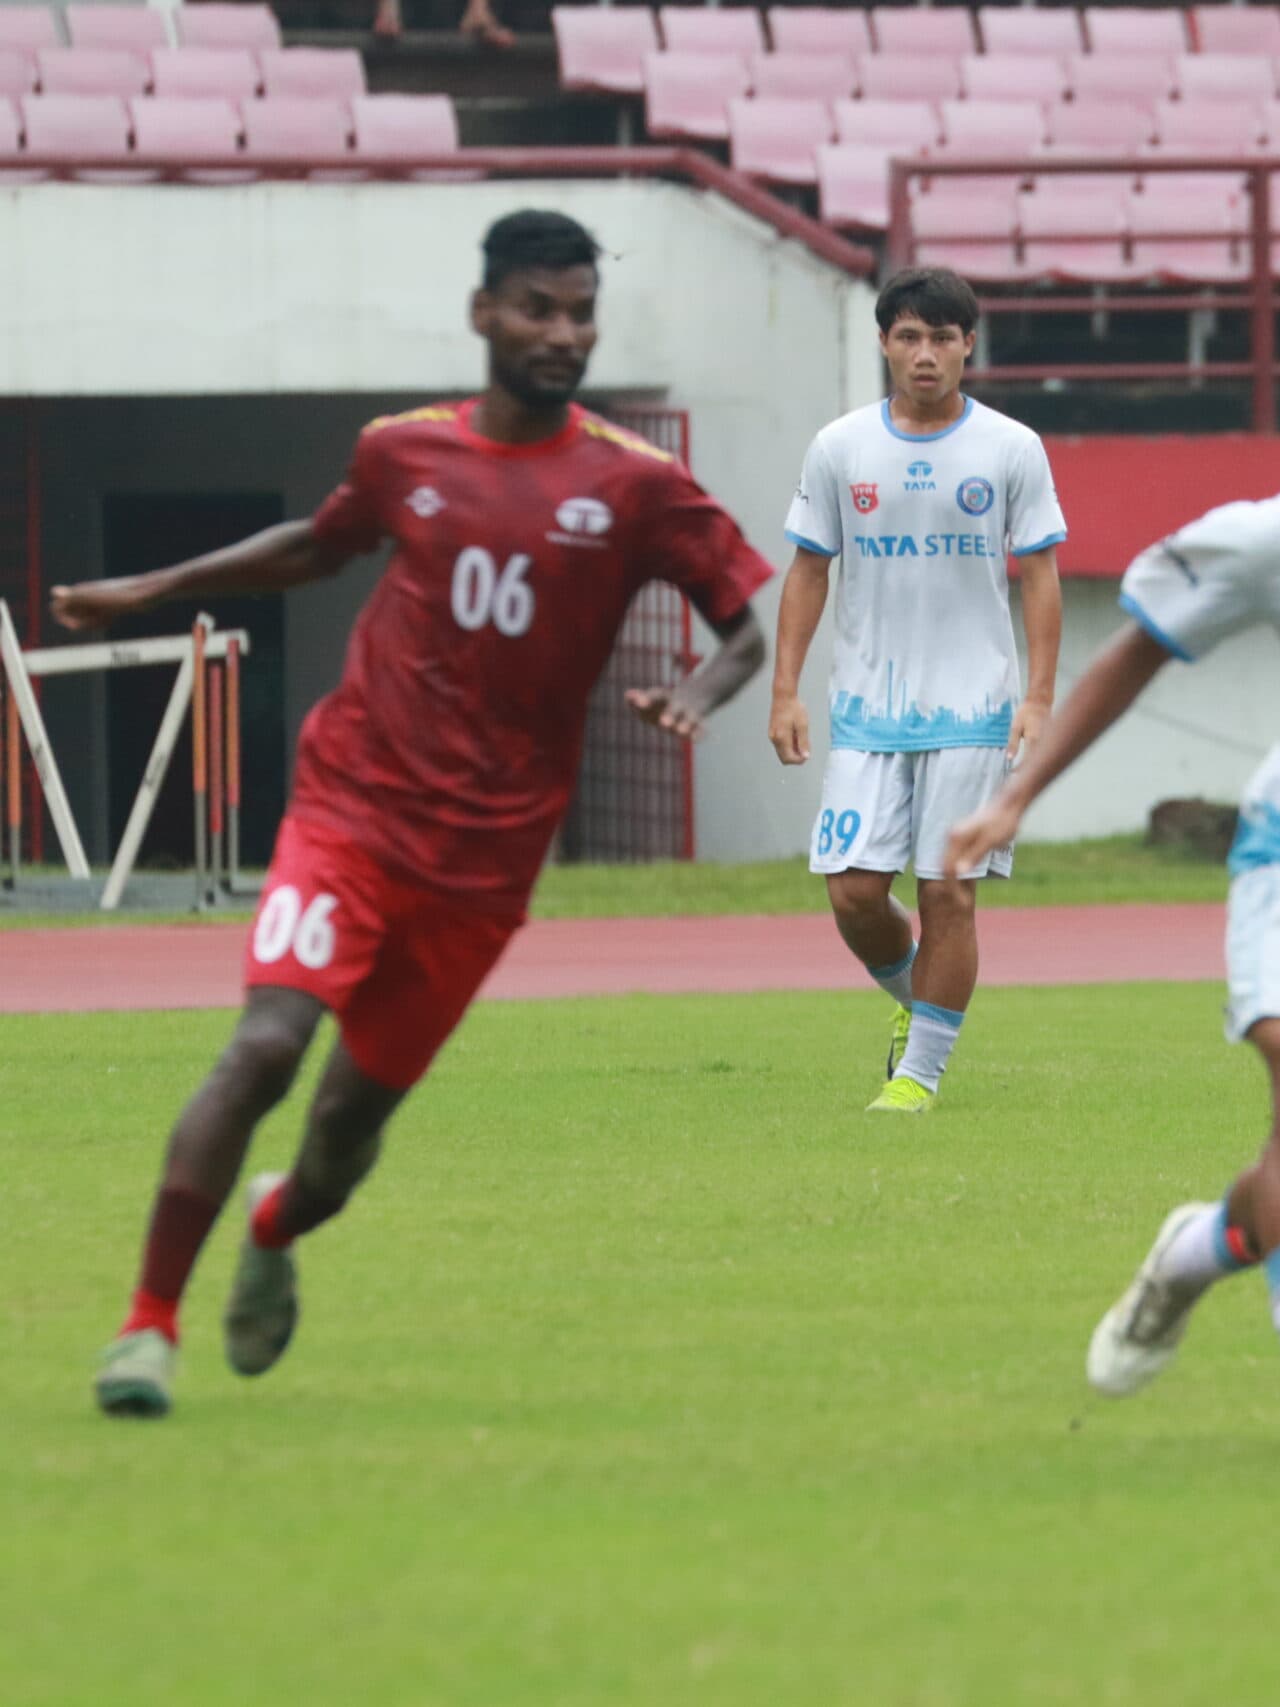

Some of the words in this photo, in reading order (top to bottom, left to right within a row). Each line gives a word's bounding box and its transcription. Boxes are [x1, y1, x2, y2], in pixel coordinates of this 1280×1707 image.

[904, 481, 936, 491] TATA
[854, 535, 919, 558] TATA
[451, 546, 535, 637] 06
[817, 808, 861, 856] 89
[253, 884, 338, 970] 06
